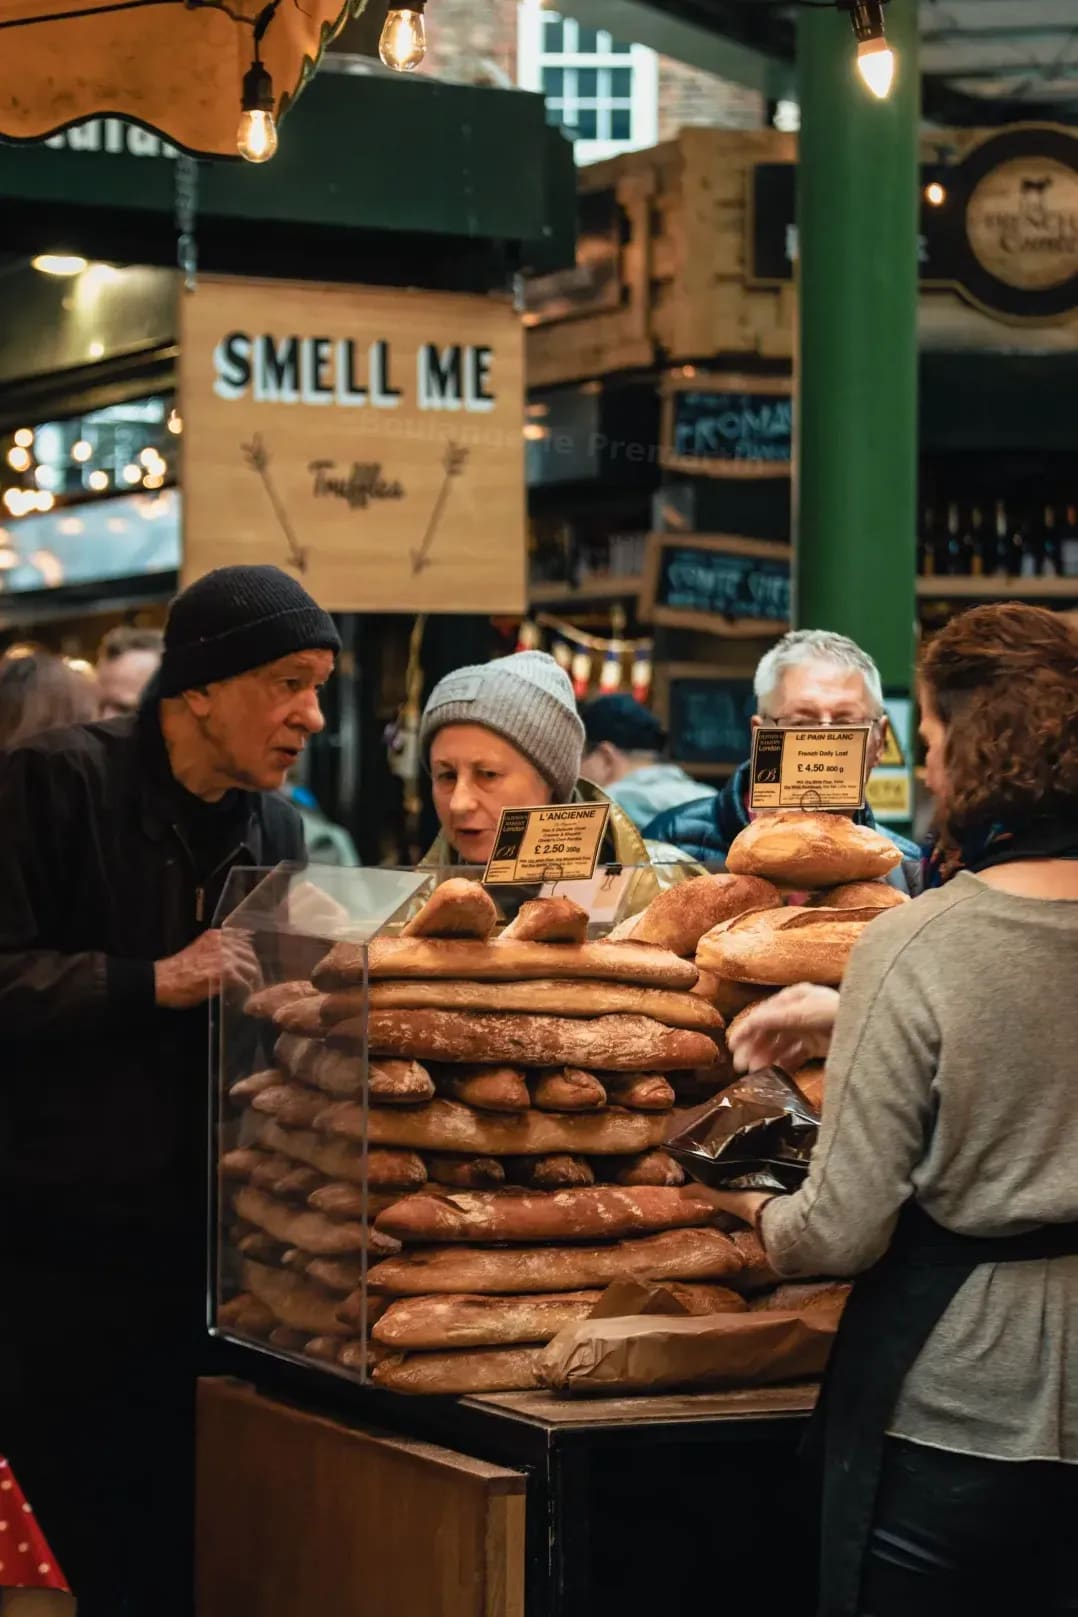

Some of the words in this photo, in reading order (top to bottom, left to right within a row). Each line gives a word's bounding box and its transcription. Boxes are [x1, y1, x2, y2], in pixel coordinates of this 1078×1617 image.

[213, 328, 404, 407] SMELL
[416, 341, 496, 413] ME
[827, 733, 854, 741] BLANC
[819, 750, 834, 758] Daily
[797, 763, 804, 773] £
[805, 763, 825, 772] 4.50
[539, 810, 597, 821] L'ANCIENNE
[534, 845, 542, 855] £
[543, 844, 565, 854] 2.50
